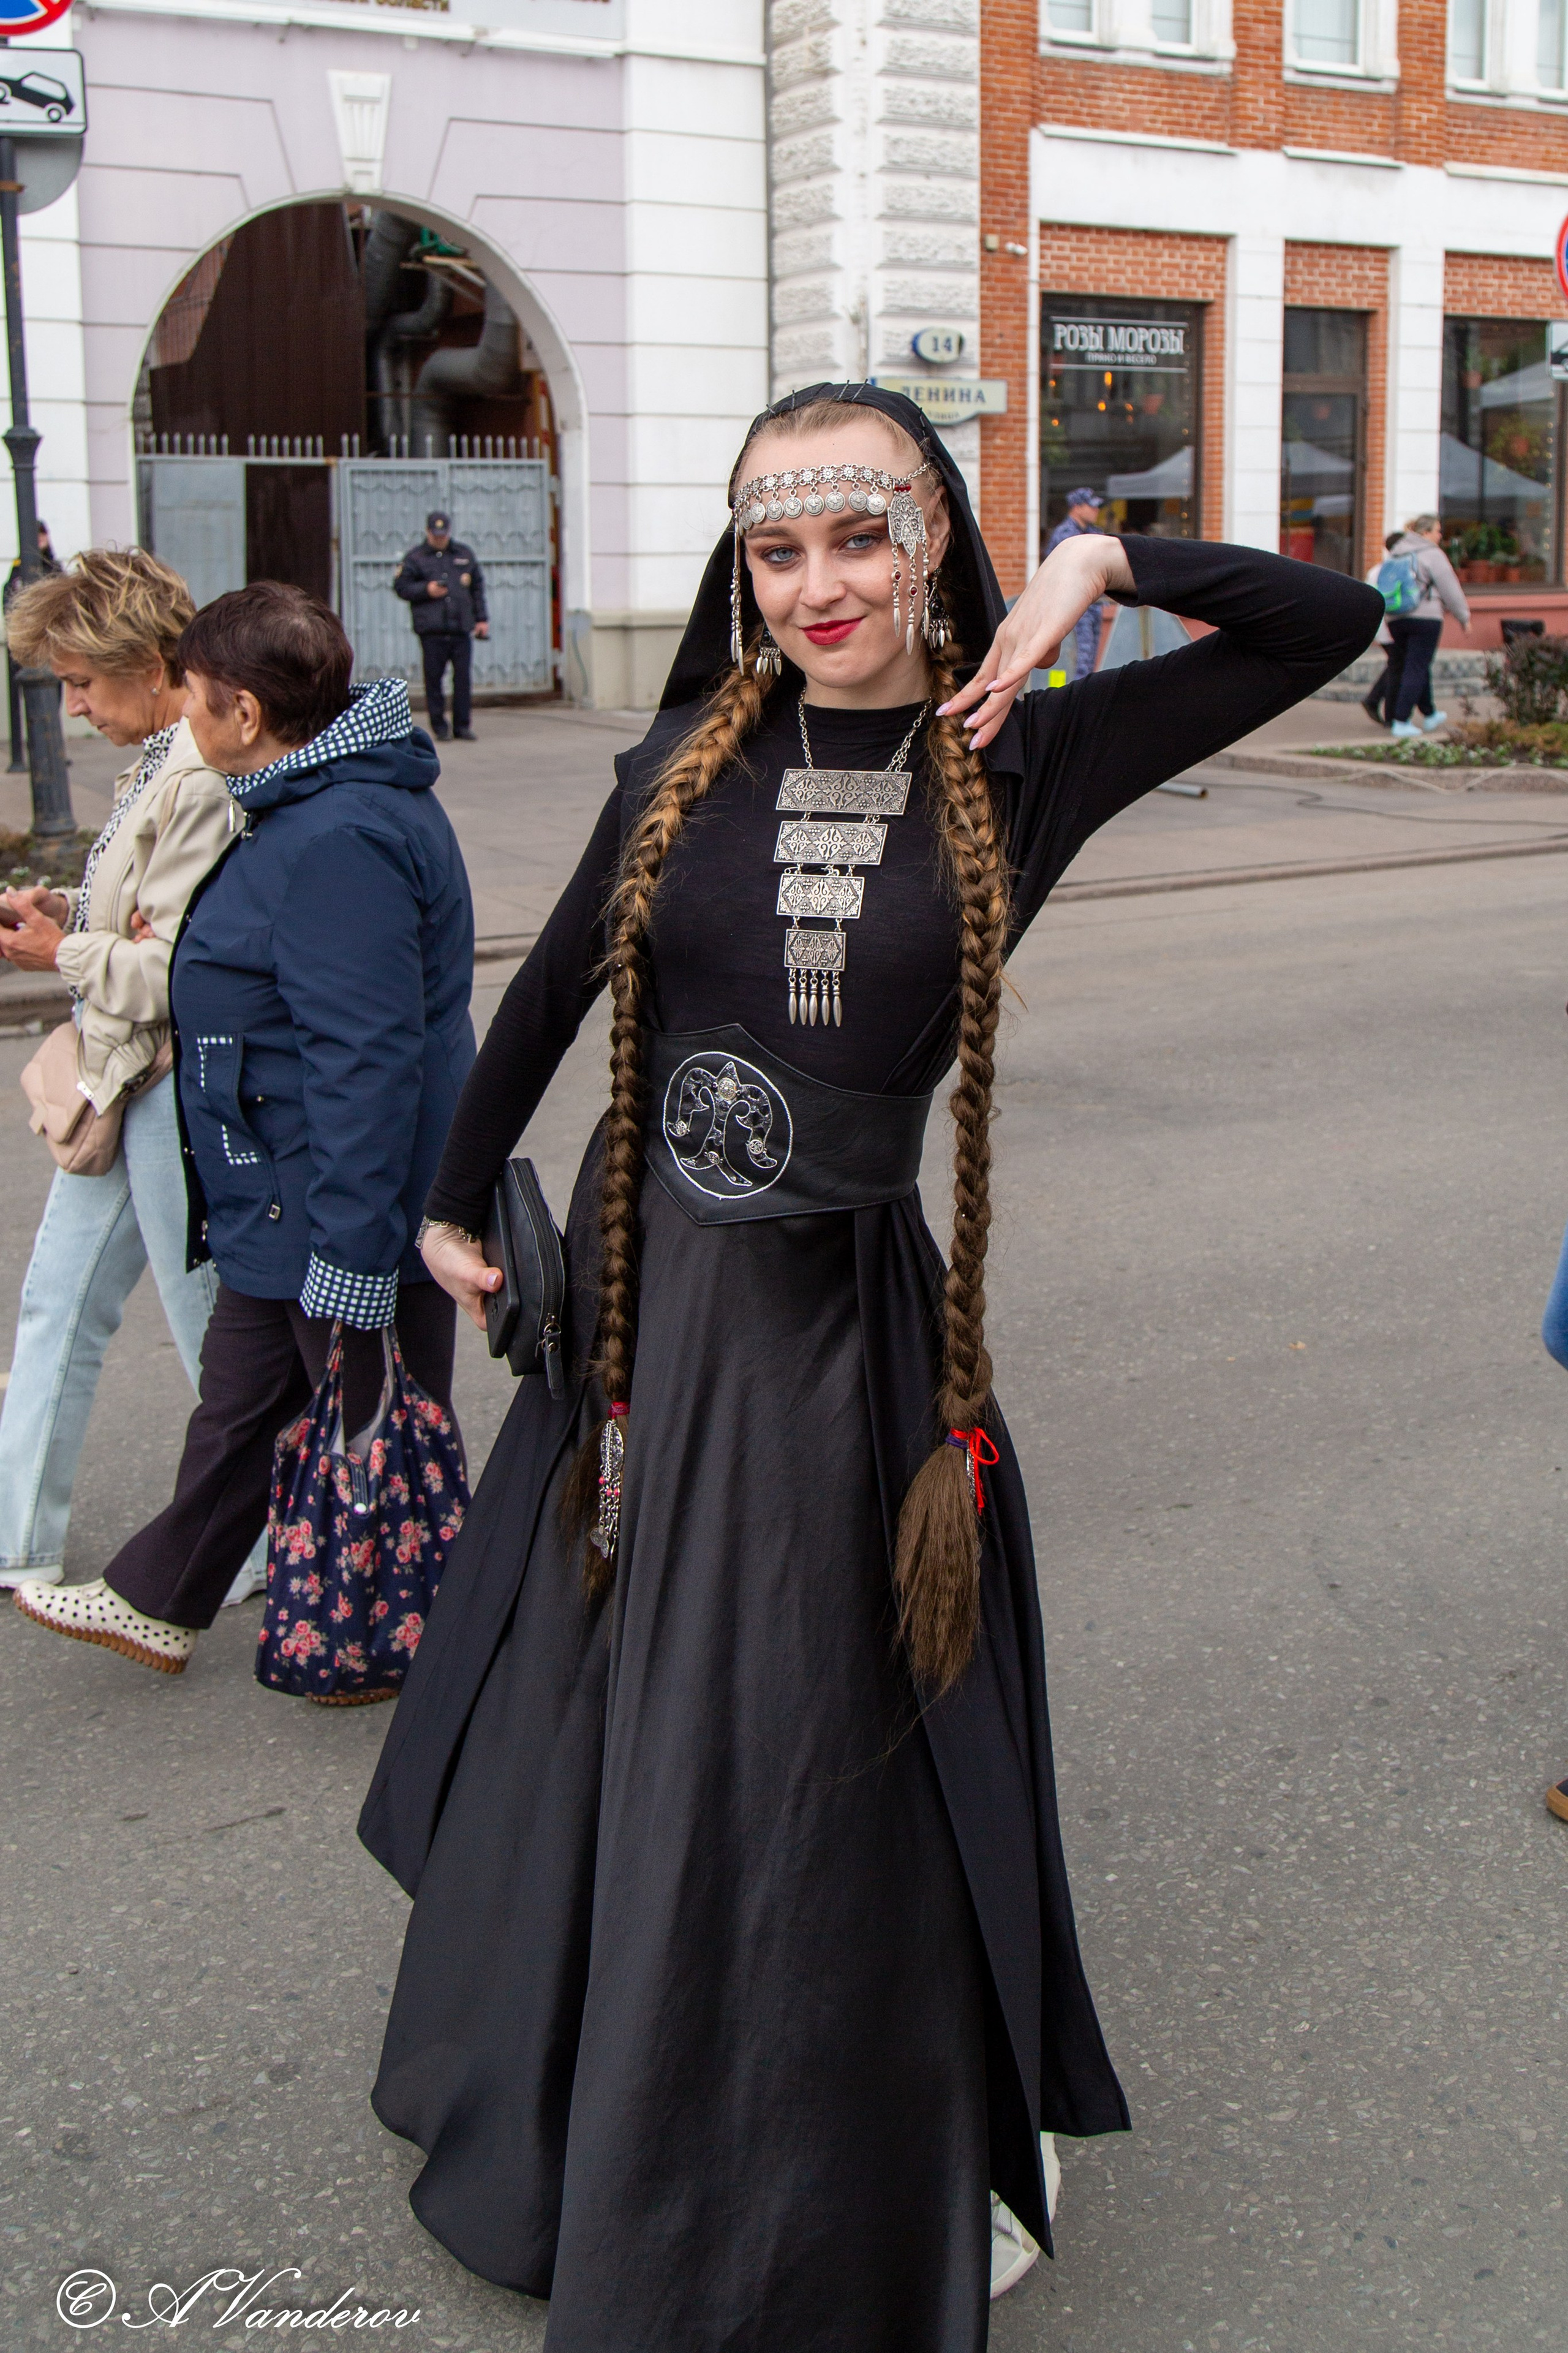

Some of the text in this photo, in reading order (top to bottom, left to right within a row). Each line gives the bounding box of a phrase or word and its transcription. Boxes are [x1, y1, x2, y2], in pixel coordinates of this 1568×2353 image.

[932, 337, 952, 352] 14
[1053, 323, 1185, 355] РОЗЫ МОРОЗЫ
[901, 385, 986, 402] ЛЕНИНА
